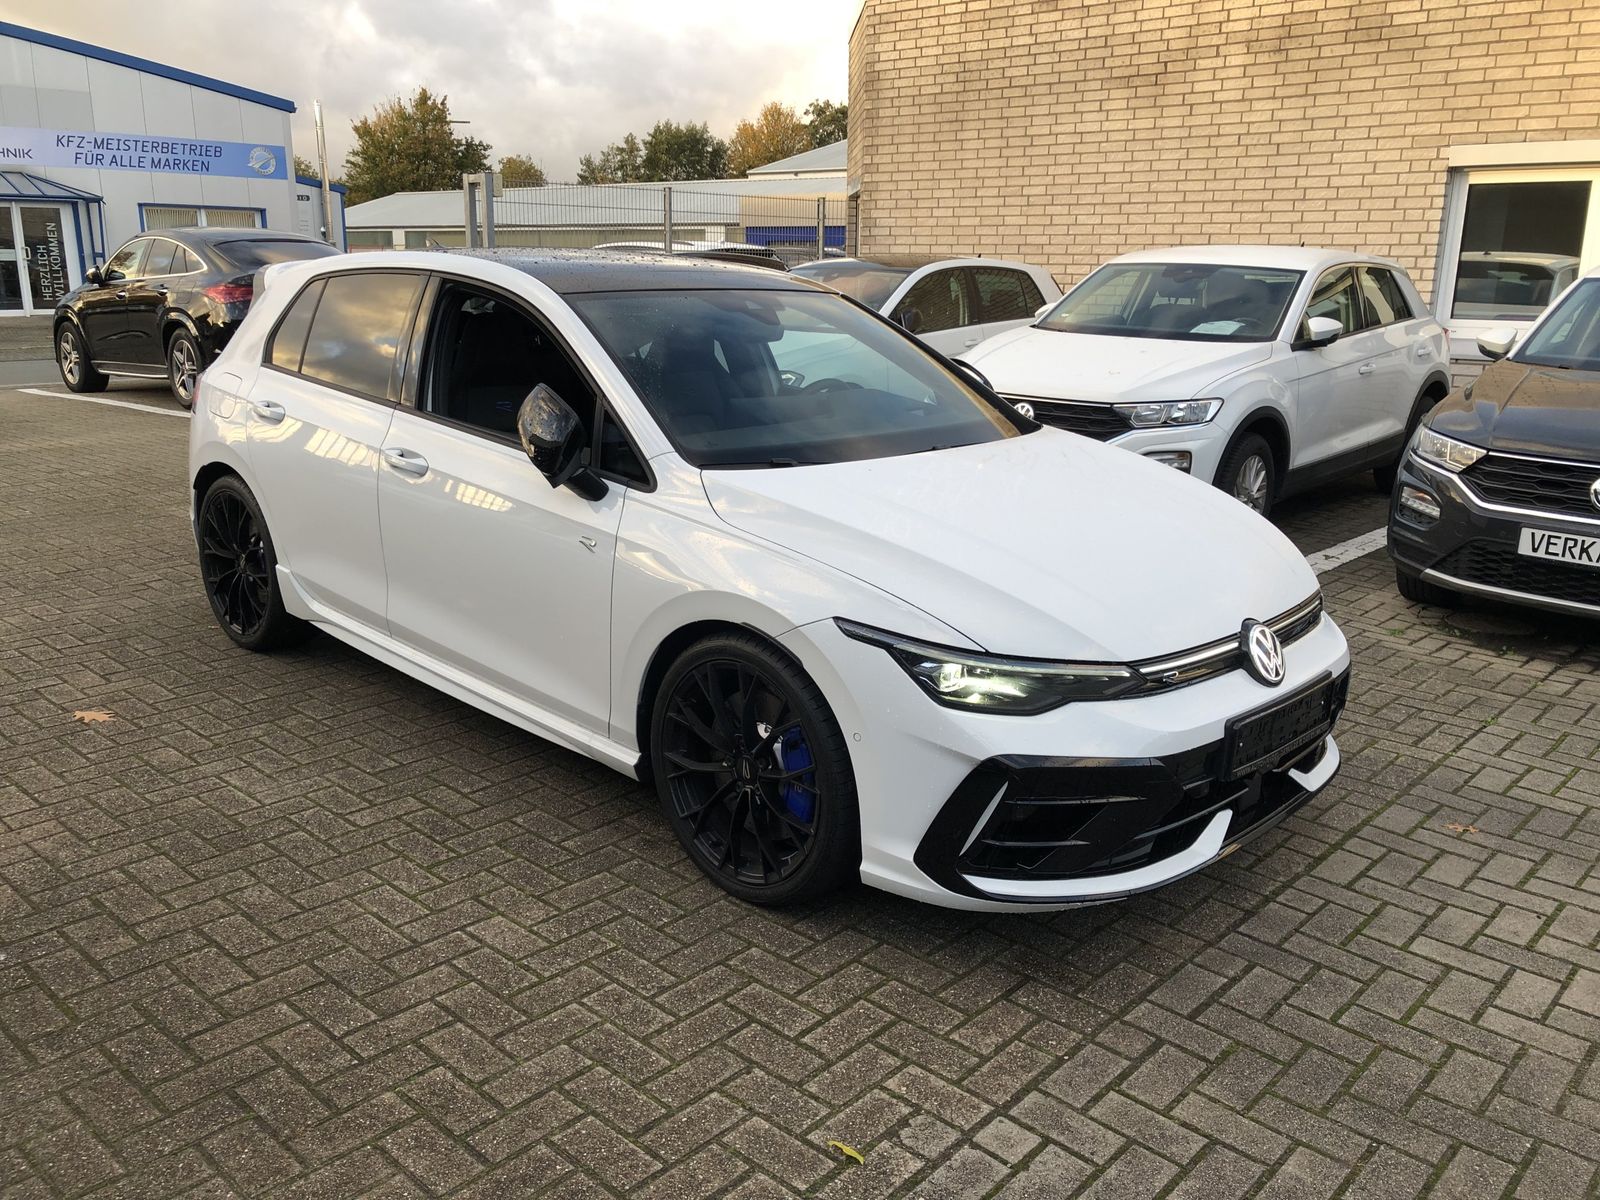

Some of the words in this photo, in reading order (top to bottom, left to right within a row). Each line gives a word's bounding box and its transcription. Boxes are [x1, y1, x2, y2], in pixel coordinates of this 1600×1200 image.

[56, 134, 223, 158] KFZ-MEISTERBETRIEB
[74, 151, 105, 167] FÜR
[109, 155, 146, 169] ALLE
[151, 159, 210, 172] MARKEN
[36, 245, 53, 301] HERZLICH
[46, 222, 65, 300] WILLKOMMEN
[1530, 532, 1600, 563] VERK
